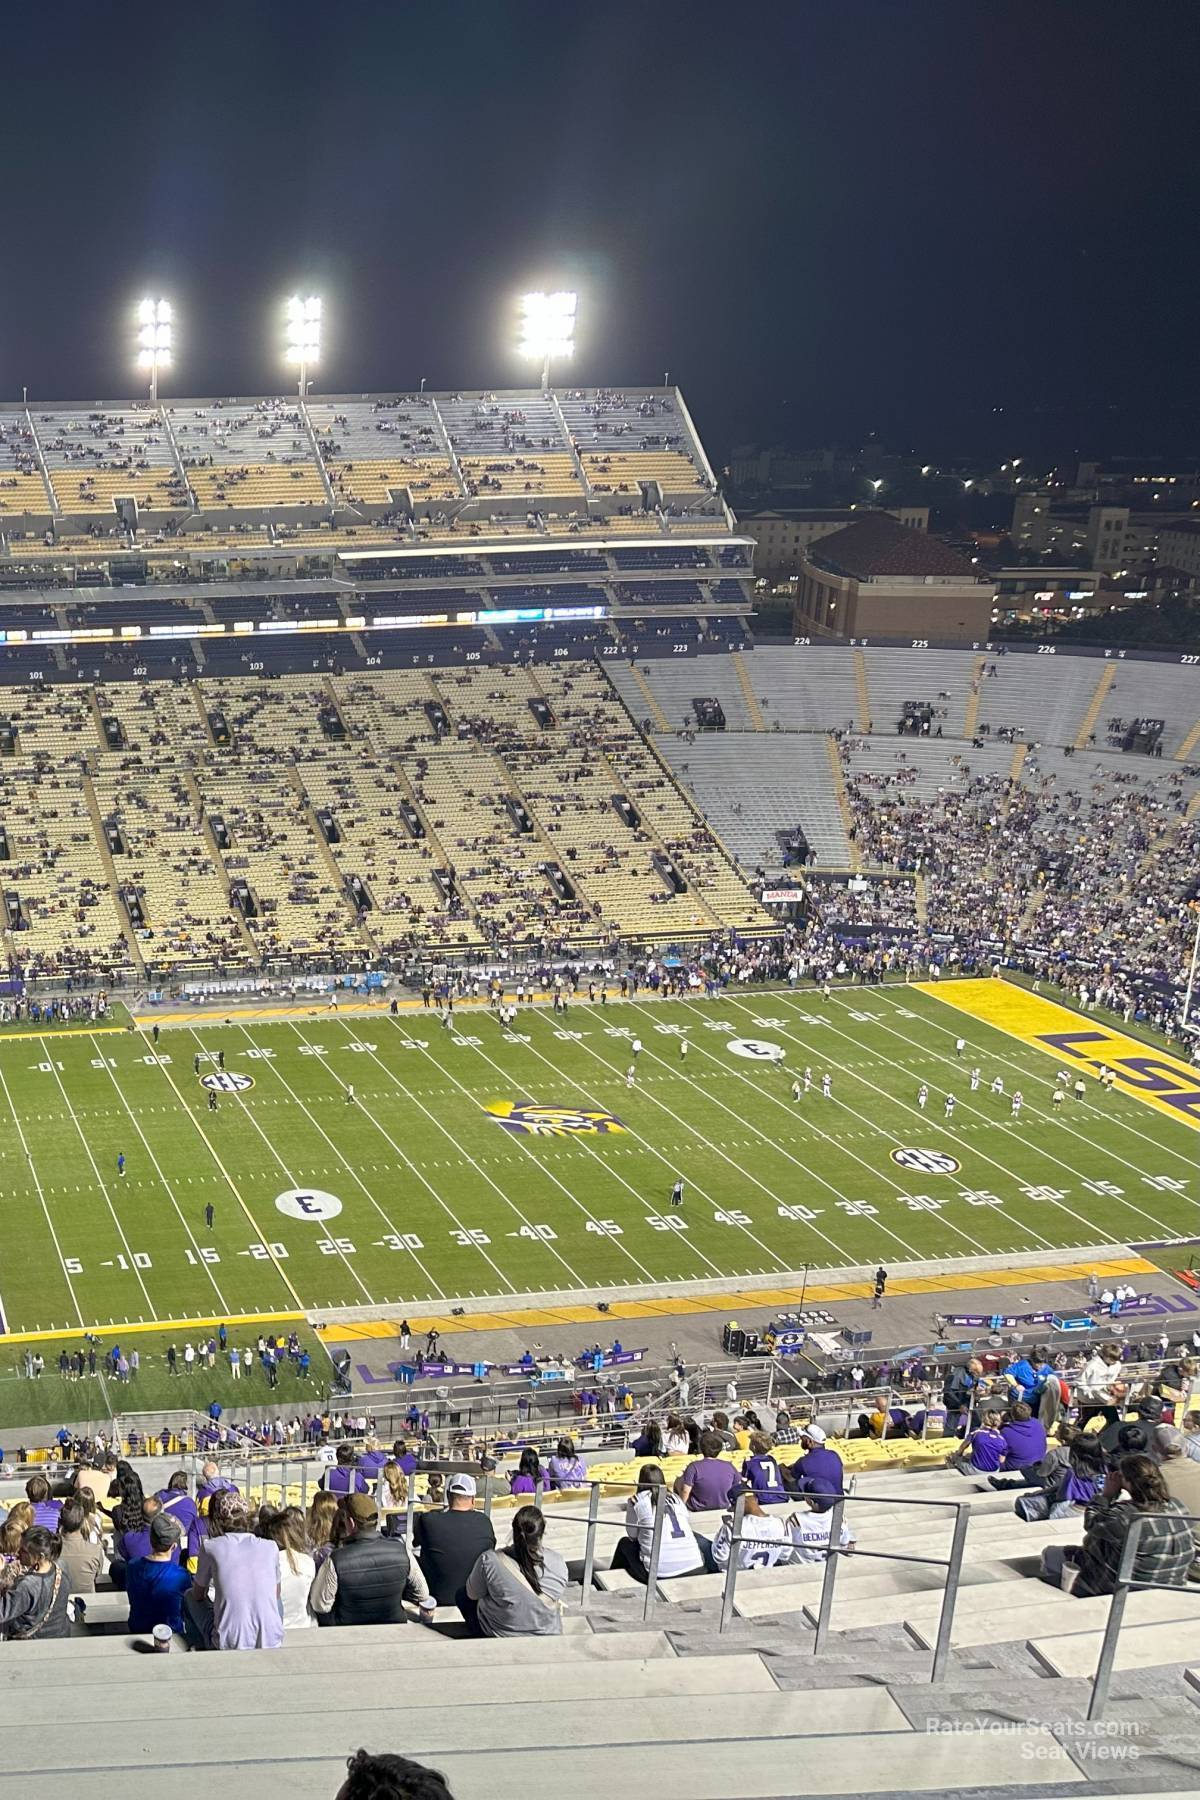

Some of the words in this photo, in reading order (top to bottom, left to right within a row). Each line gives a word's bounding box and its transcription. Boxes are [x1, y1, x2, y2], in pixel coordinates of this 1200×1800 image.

[672, 644, 688, 653] 223
[794, 637, 810, 645] 224
[912, 640, 928, 648] 225
[466, 652, 481, 661] 105
[554, 648, 569, 656] 106
[603, 646, 618, 655] 222
[1038, 645, 1055, 654] 226
[249, 662, 264, 671] 103
[366, 657, 381, 665] 104
[1180, 655, 1200, 664] 227
[29, 671, 44, 680] 101
[133, 667, 147, 676] 102
[200, 1072, 253, 1091] SEC
[895, 1149, 956, 1173] SEC
[1081, 1180, 1125, 1195] 15
[1141, 1176, 1184, 1191] 10
[958, 1190, 1003, 1206] 25
[1019, 1185, 1063, 1201] 20
[835, 1200, 879, 1216] 35
[897, 1195, 941, 1211] 30
[714, 1210, 753, 1226] 45
[777, 1205, 816, 1221] 40
[585, 1220, 624, 1236] 45
[645, 1215, 689, 1231] 50
[449, 1229, 491, 1245] 35
[519, 1224, 558, 1241] 40
[316, 1238, 356, 1255] 25
[383, 1234, 424, 1250] 30
[185, 1248, 220, 1265] 15
[249, 1243, 289, 1260] 20
[65, 1258, 84, 1273] 5
[117, 1253, 152, 1270] 10
[760, 1461, 778, 1487] 7
[665, 1501, 686, 1538] 1
